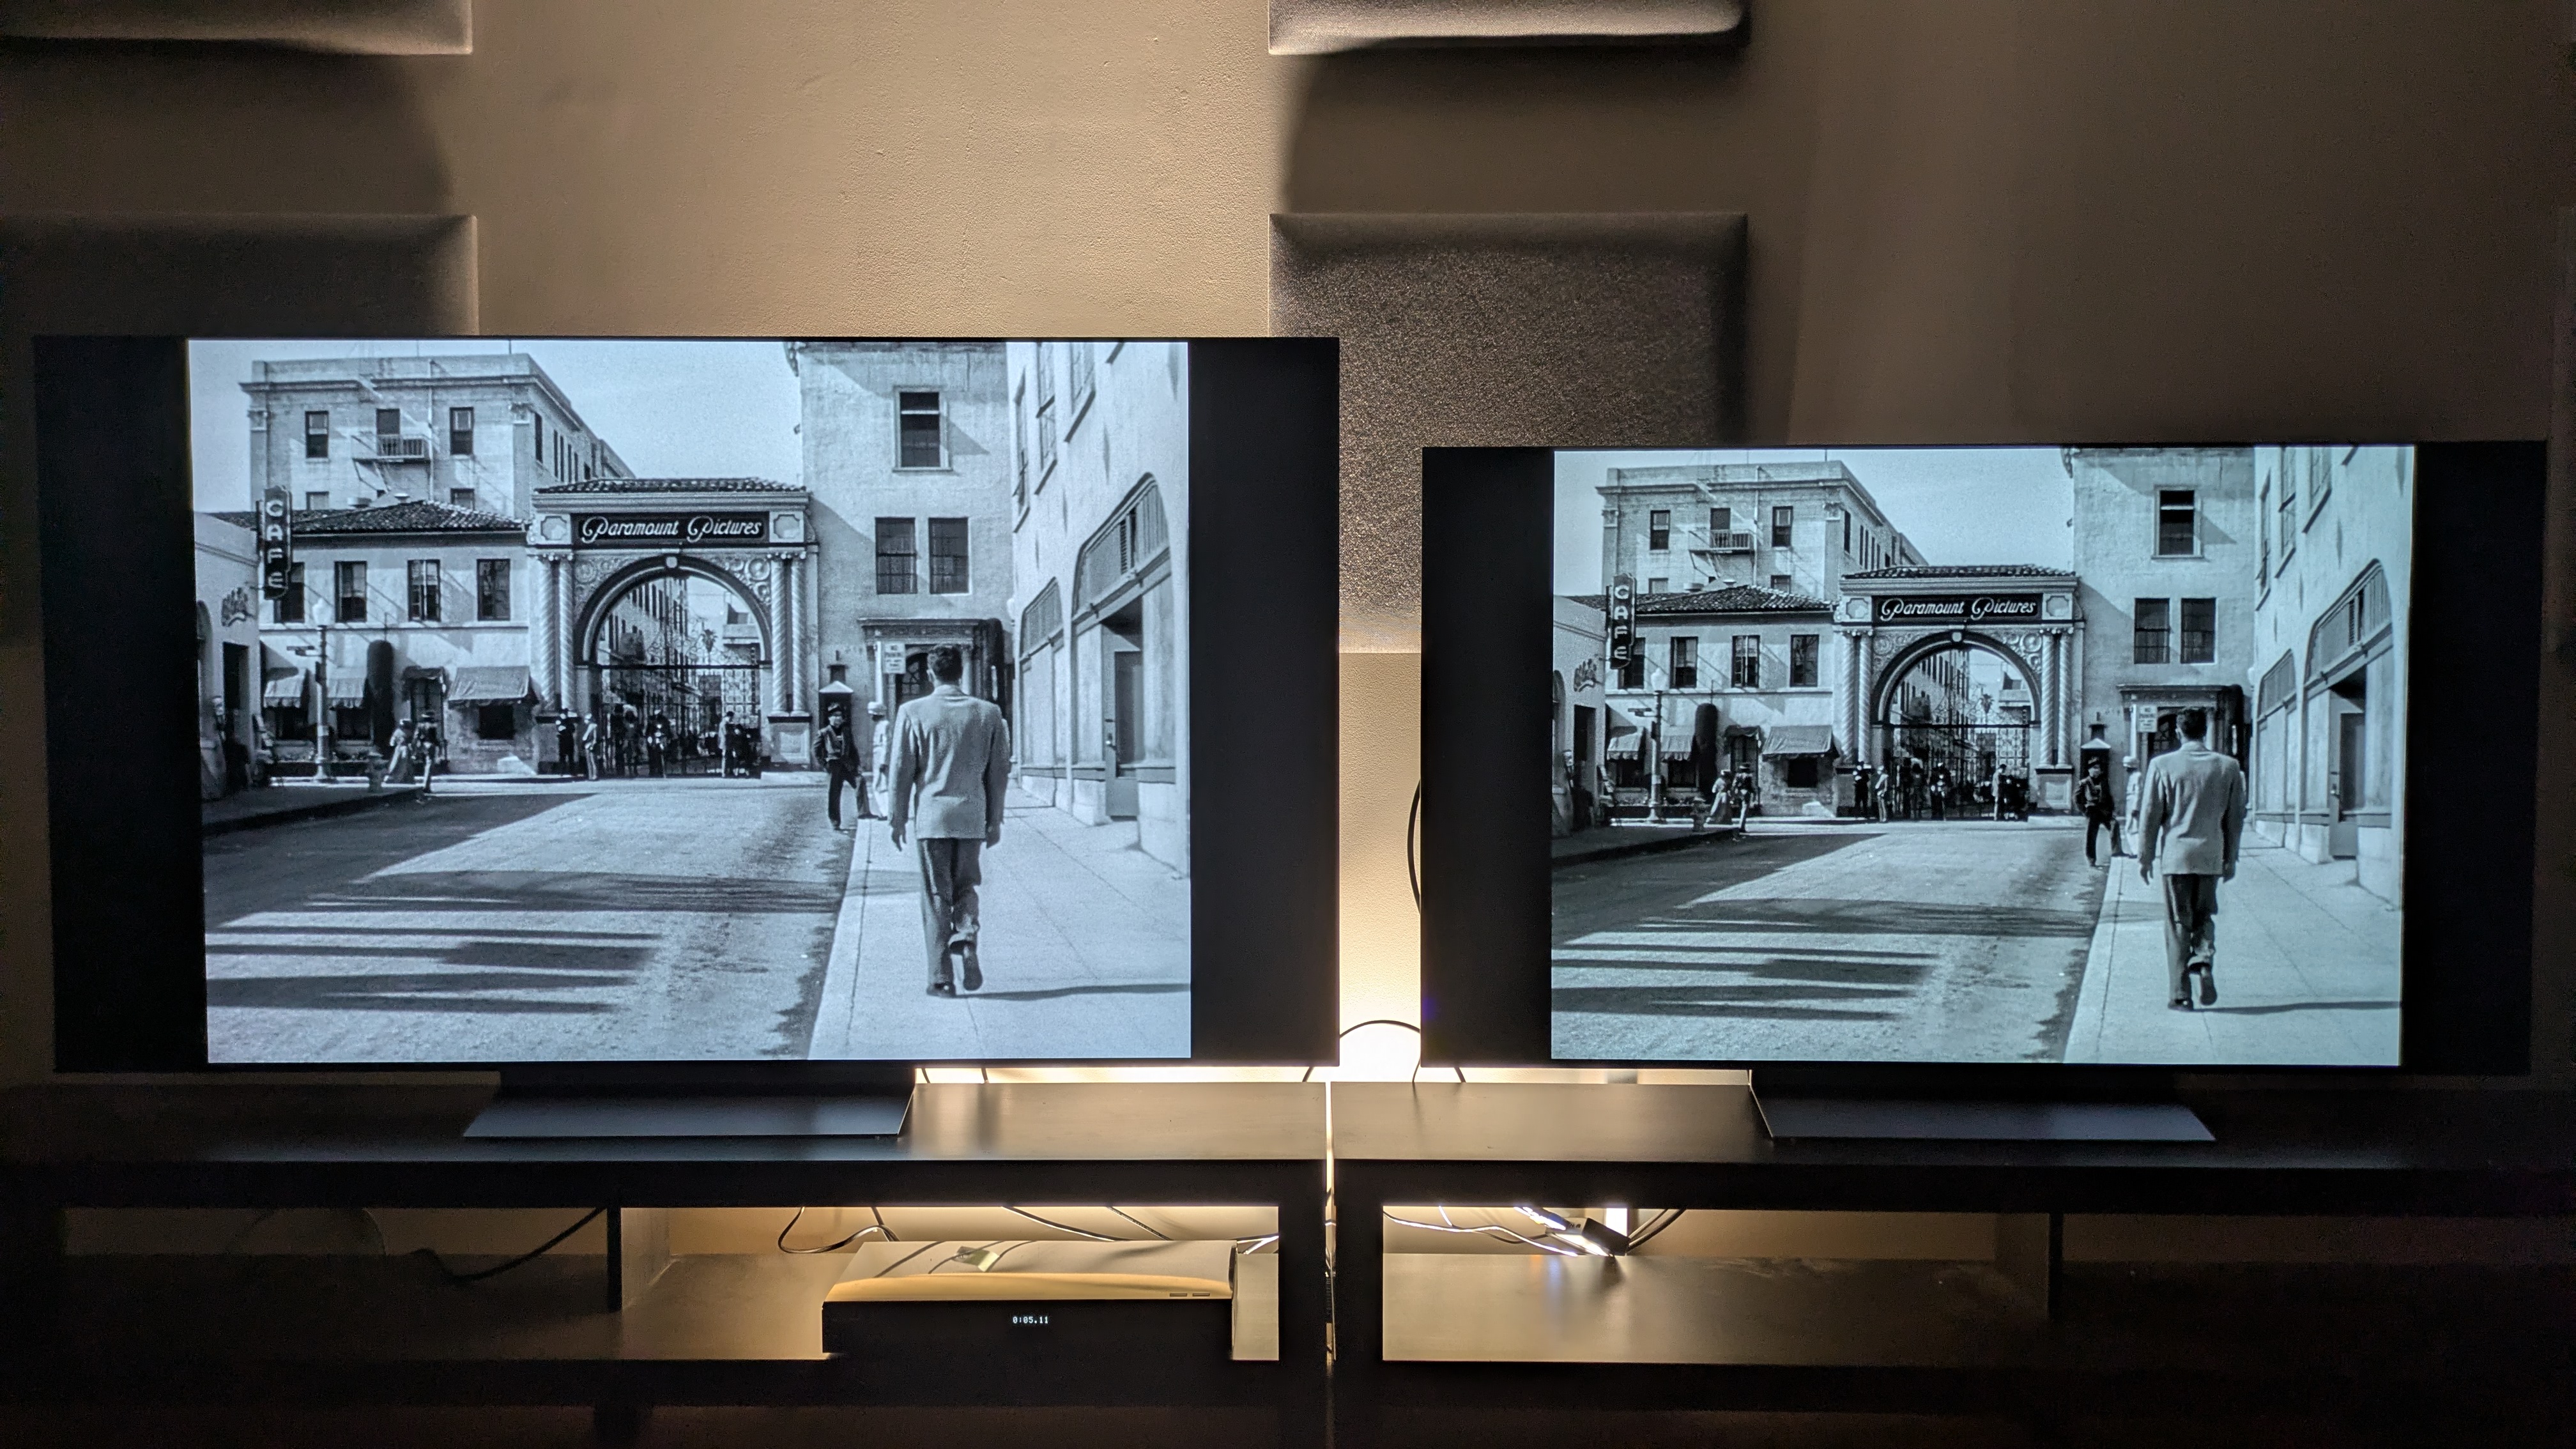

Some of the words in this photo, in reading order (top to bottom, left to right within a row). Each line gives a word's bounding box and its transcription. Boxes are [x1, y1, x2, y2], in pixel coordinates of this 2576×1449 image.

[266, 500, 284, 588] CAFE
[581, 516, 678, 543] Paramount
[687, 515, 762, 542] Pictures
[1614, 585, 1630, 659] CAFE
[1880, 597, 1965, 621] Paramount
[1970, 597, 2035, 620] Pictures
